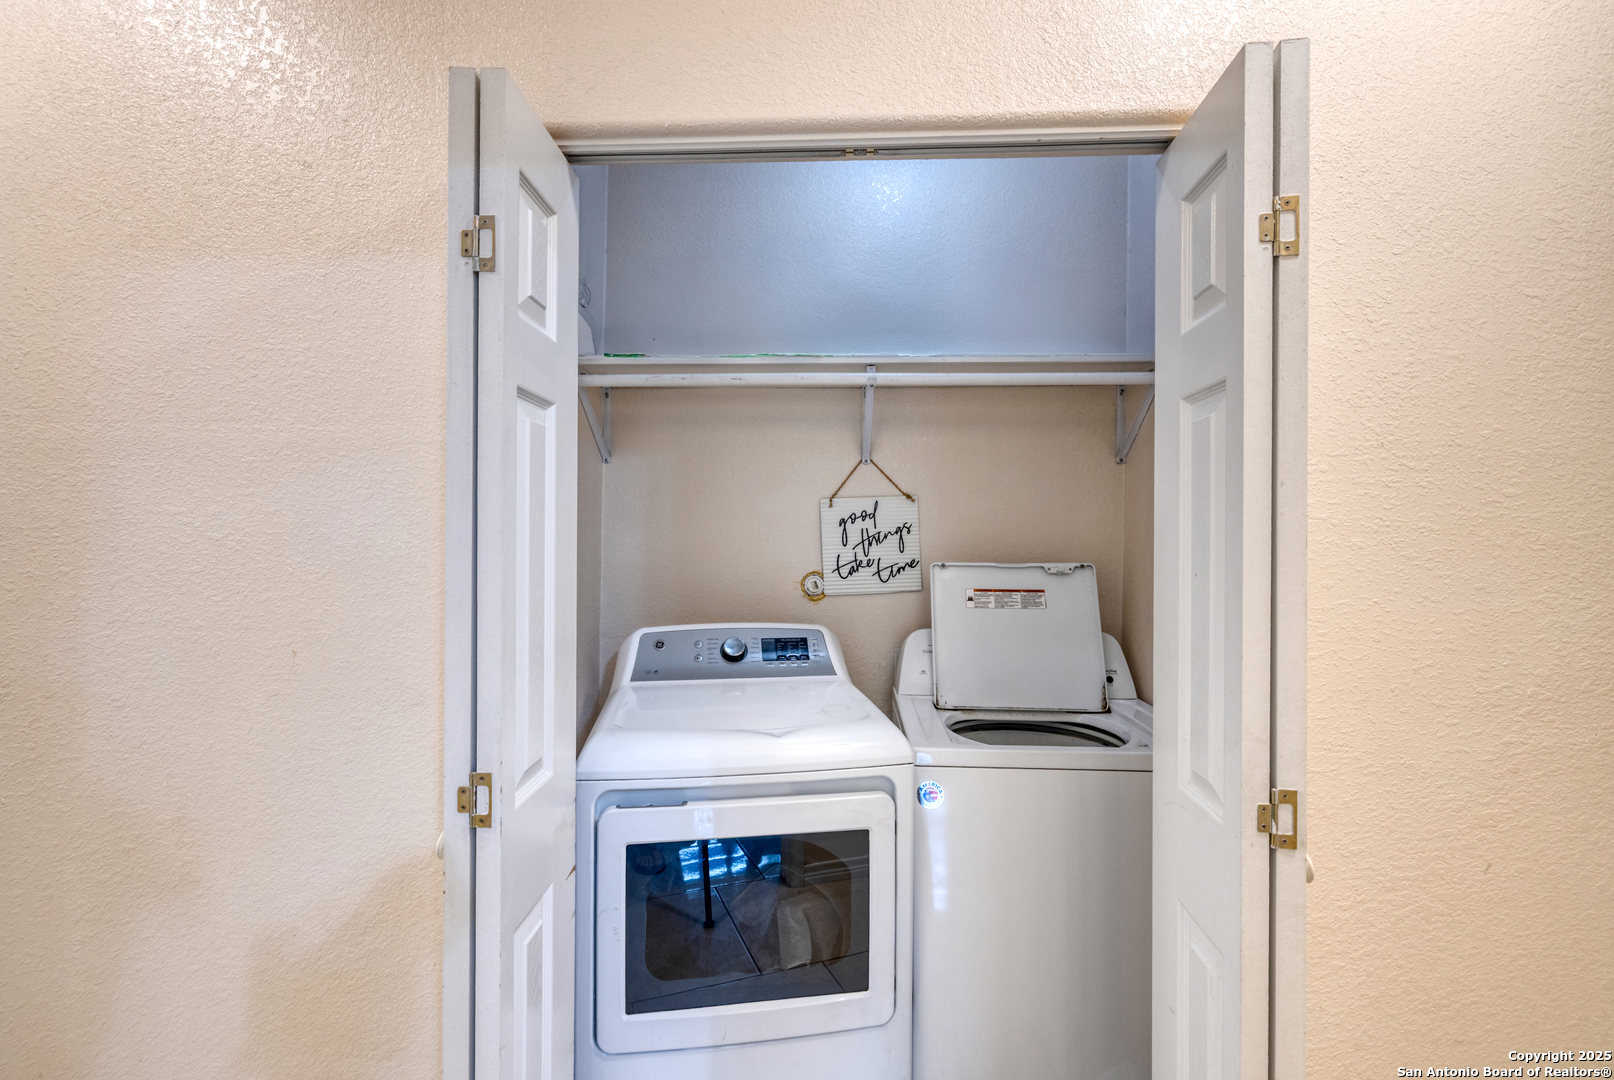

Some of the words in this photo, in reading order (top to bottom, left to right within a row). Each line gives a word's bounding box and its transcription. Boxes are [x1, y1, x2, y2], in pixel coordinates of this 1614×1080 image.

[839, 501, 878, 547] good
[853, 522, 912, 557] things
[832, 552, 875, 579] take
[872, 558, 919, 583] time
